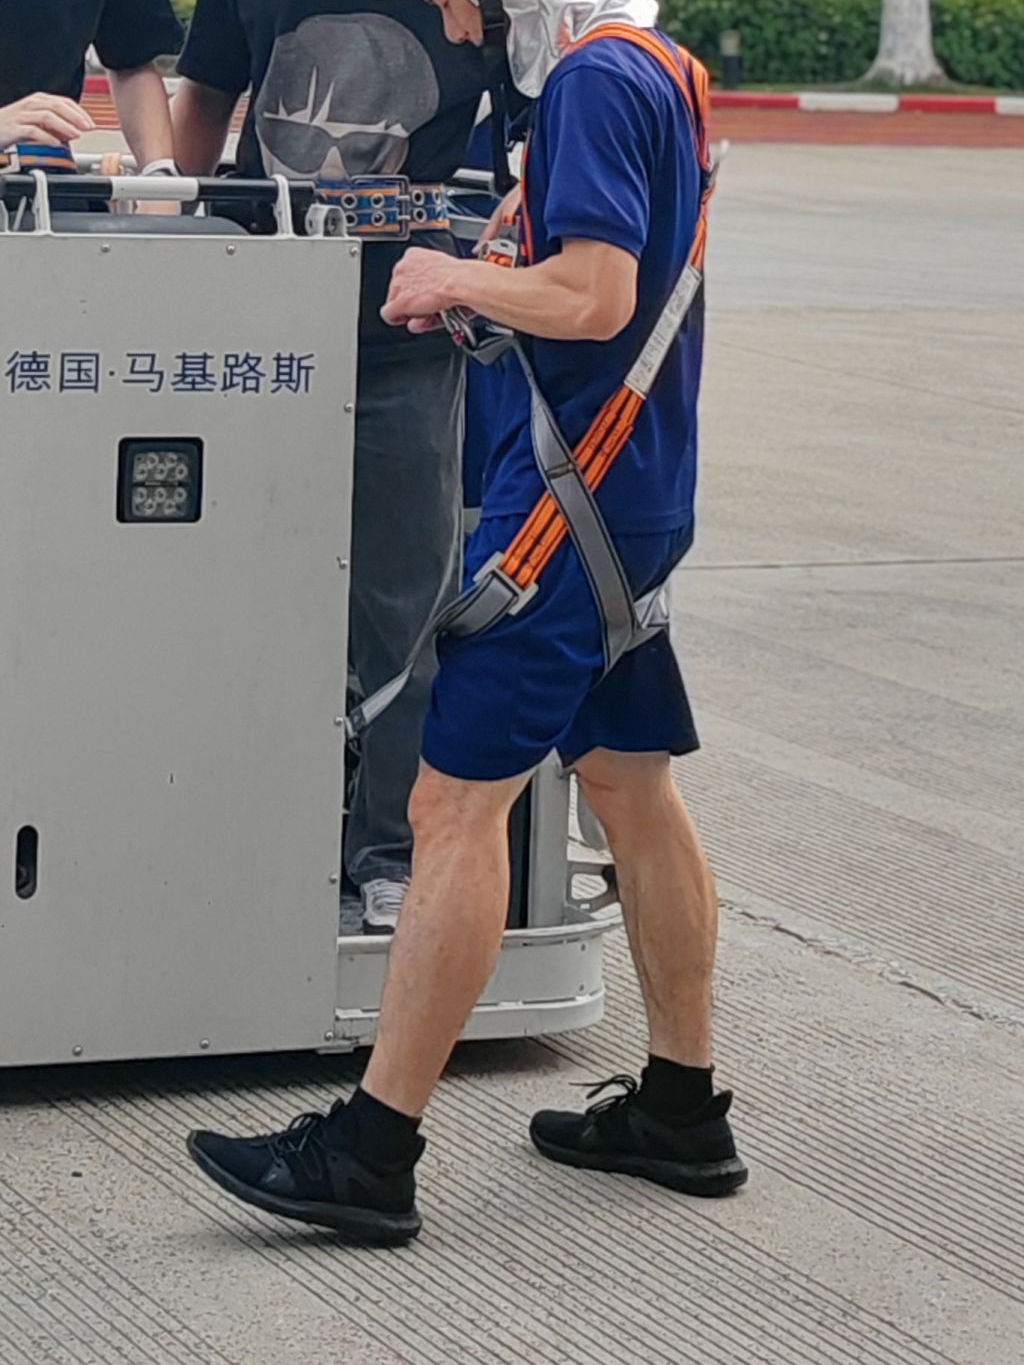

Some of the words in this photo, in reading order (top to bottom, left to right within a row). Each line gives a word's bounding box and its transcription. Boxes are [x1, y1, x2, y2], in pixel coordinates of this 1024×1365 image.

[5, 350, 316, 394] 德国·马基路斯
